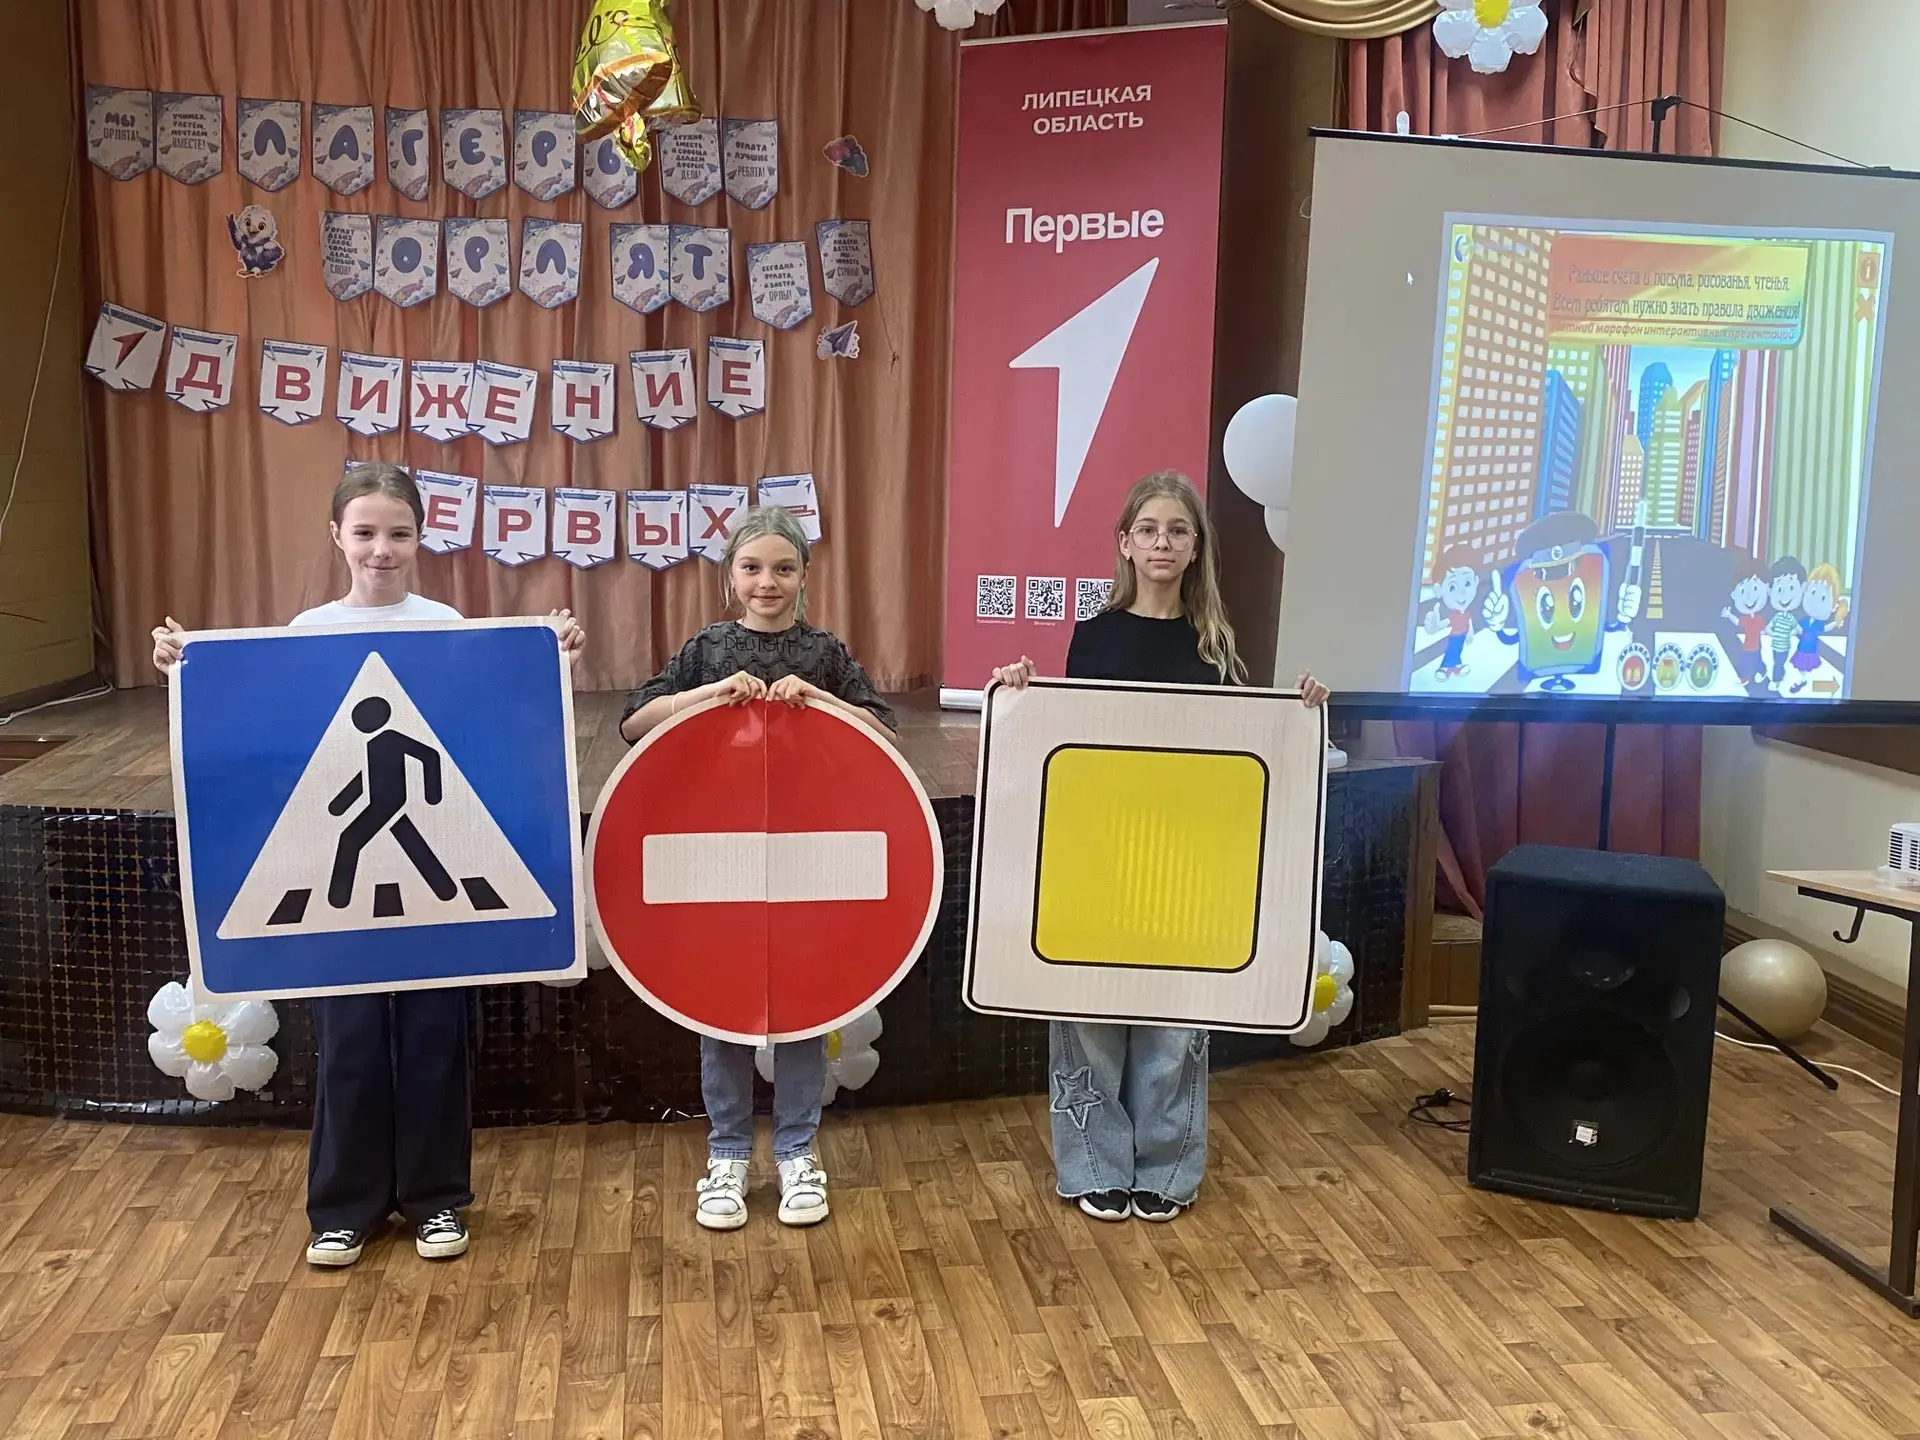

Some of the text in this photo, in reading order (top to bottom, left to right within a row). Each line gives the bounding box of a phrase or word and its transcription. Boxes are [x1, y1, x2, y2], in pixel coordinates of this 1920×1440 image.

[1022, 84, 1152, 110] ЛИПЕЦКАЯ
[105, 112, 136, 127] МЫ
[1033, 111, 1144, 135] ОБЛАСТЬ
[103, 127, 139, 142] ОРЛЯТА!
[171, 137, 206, 150] ВМЕСТЕ!
[253, 117, 621, 176] ЛАГЕРЬ
[734, 151, 769, 162] ЛУЧШИЕ
[737, 165, 766, 178] РЕБЯТА!
[1005, 207, 1165, 254] Первые
[391, 236, 714, 281] ОРЛЯТ
[762, 263, 794, 272] СЕГОДНЯ
[1612, 270, 1640, 285] счета
[1643, 272, 1650, 286] и
[1654, 273, 1695, 288] письма,
[769, 290, 792, 301] ОРЛЫ!
[1553, 292, 1801, 321] Всем ребятам нужно знать правила движения!
[1594, 322, 1644, 338] марафон
[174, 352, 752, 425] ДВИЖЕНИЕ
